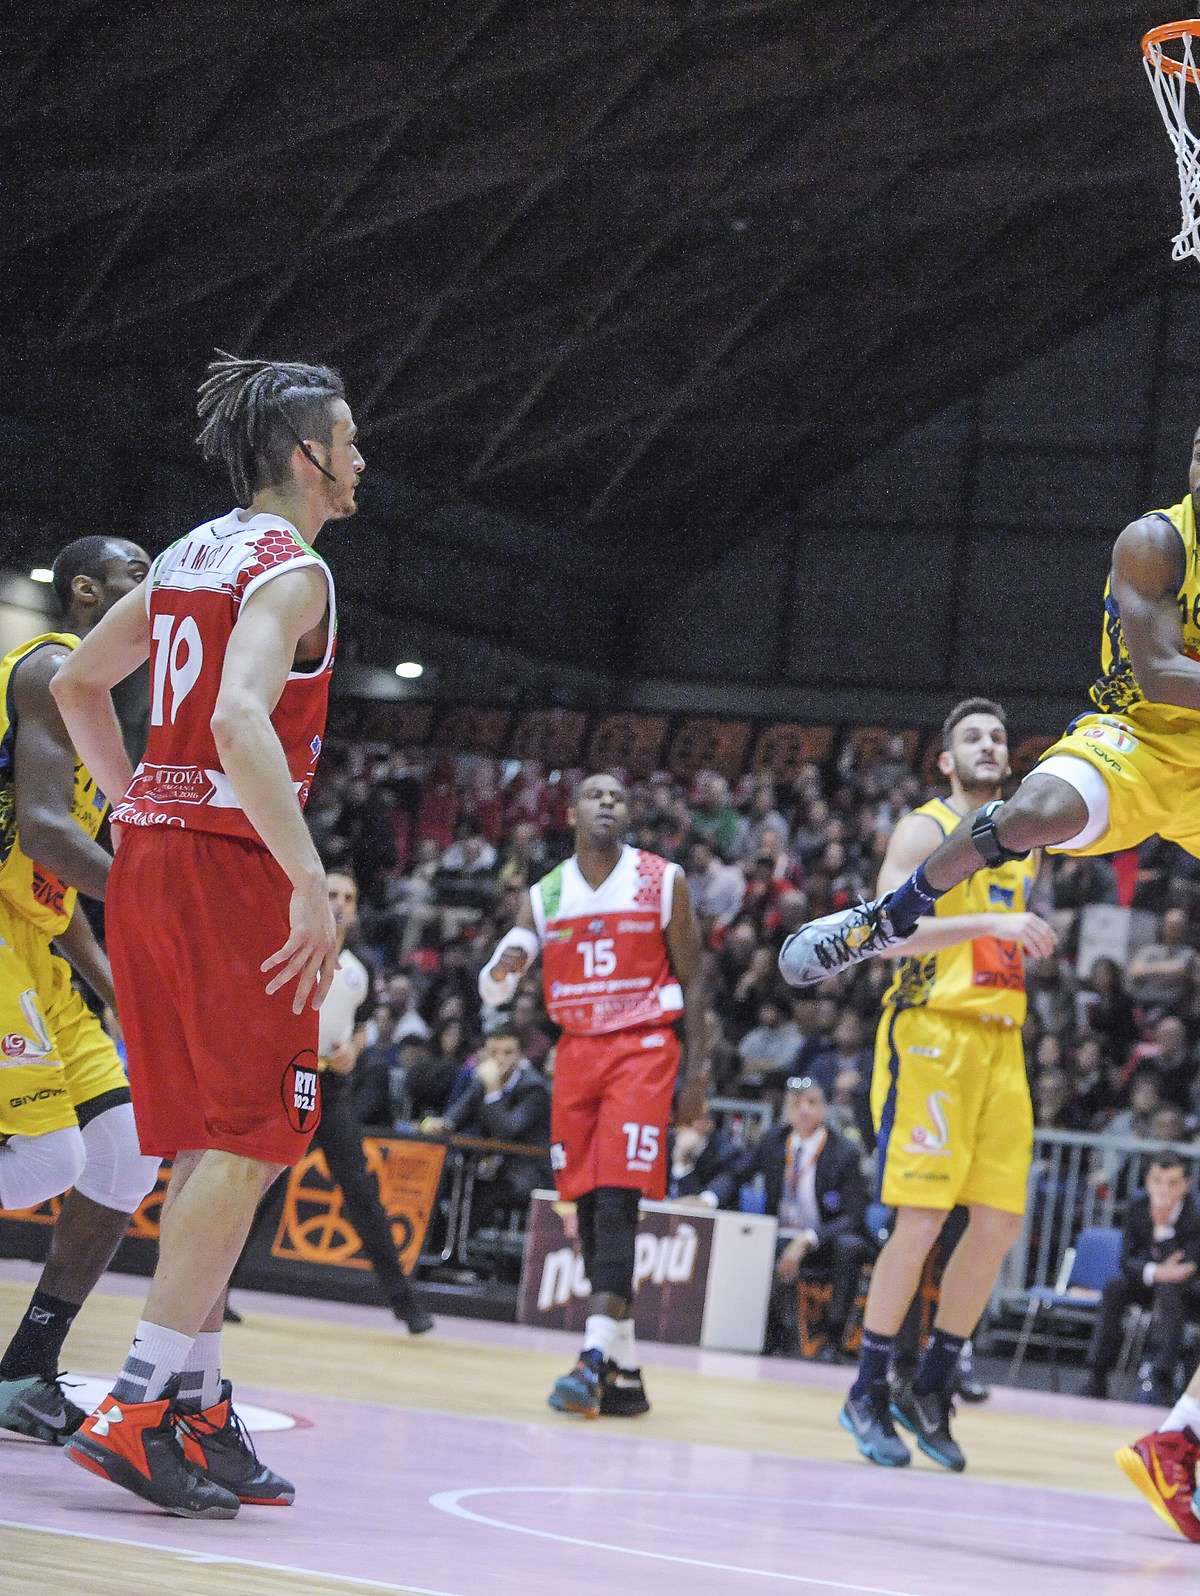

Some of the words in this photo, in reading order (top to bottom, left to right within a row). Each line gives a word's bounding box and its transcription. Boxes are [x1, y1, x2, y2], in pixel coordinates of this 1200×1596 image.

[151, 613, 203, 726] 19
[576, 938, 617, 978] 15
[294, 1070, 317, 1097] RTL
[622, 1122, 660, 1161] 15
